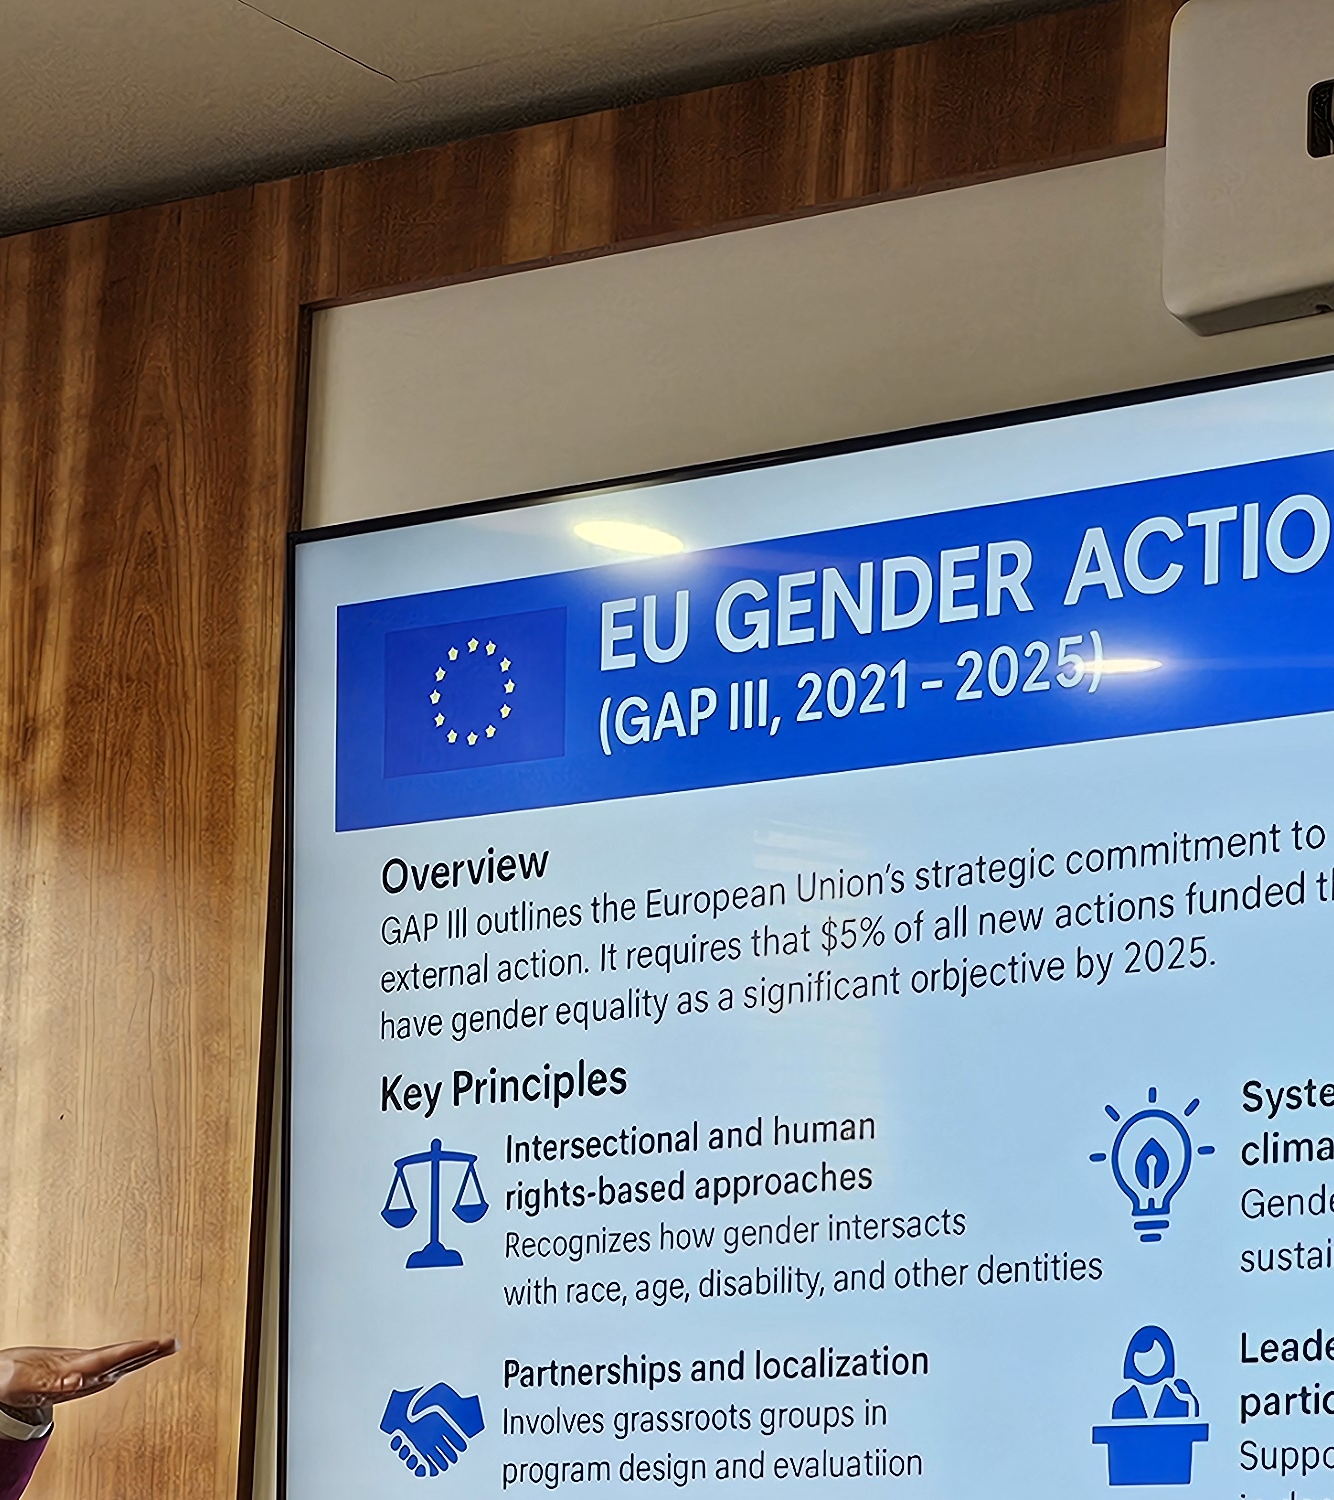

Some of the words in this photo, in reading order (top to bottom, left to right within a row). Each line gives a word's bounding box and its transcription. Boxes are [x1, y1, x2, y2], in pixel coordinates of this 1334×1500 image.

[599, 589, 691, 672] EU
[715, 540, 1034, 653] GENDER
[599, 687, 717, 756] (GAP
[729, 678, 781, 736] III,
[796, 659, 907, 722] 2021
[955, 629, 1105, 701] 2025)
[381, 912, 439, 946] GAP
[448, 906, 467, 940] III
[476, 900, 583, 936] outlines
[590, 891, 636, 924] the
[646, 882, 786, 920] European
[914, 847, 1055, 891] strategic
[1066, 823, 1282, 875] commitment
[1290, 820, 1326, 851] to
[382, 846, 550, 895] Overview
[380, 952, 488, 994] external
[497, 948, 590, 983] action.
[600, 943, 618, 973] It
[626, 933, 742, 974] requires
[750, 924, 811, 958] that
[821, 914, 886, 957] $5%
[894, 909, 925, 945] of
[934, 904, 967, 941] all
[979, 906, 1044, 936] new
[1055, 891, 1175, 929] actions
[1184, 870, 1305, 916] funded
[380, 1010, 443, 1040] have
[451, 998, 549, 1042] gender
[555, 987, 669, 1031] equality
[676, 990, 709, 1015] as
[717, 988, 733, 1012] a
[743, 966, 901, 1014] significant
[911, 951, 1065, 998] orbjective
[1076, 945, 1114, 986] by
[1124, 935, 1216, 974] 2025.
[381, 1073, 443, 1119] Key
[453, 1058, 627, 1109] Principles
[506, 1120, 698, 1164] Intersectional
[708, 1116, 763, 1150] and
[774, 1115, 875, 1146] human
[506, 1169, 685, 1218] rights-based
[694, 1160, 873, 1206] approaches
[505, 1226, 651, 1263] Recognizes
[659, 1221, 716, 1251] how
[723, 1214, 820, 1255] gender
[828, 1208, 966, 1242] intersacts
[503, 1276, 557, 1306] with
[566, 1281, 628, 1307] race,
[635, 1278, 690, 1307] age,
[698, 1265, 825, 1300] disability,
[833, 1259, 885, 1293] and
[894, 1257, 970, 1290] other
[977, 1251, 1103, 1286] dentities
[504, 1353, 682, 1391] Partnerships
[690, 1349, 745, 1382] and
[755, 1344, 929, 1380] localization
[503, 1405, 605, 1436] Involves
[613, 1403, 752, 1440] grassroots
[760, 1405, 855, 1436] groups
[864, 1398, 887, 1426] in
[502, 1460, 611, 1491] program
[619, 1452, 706, 1488] design
[715, 1449, 765, 1480] and
[773, 1448, 922, 1480] evaluatiion
